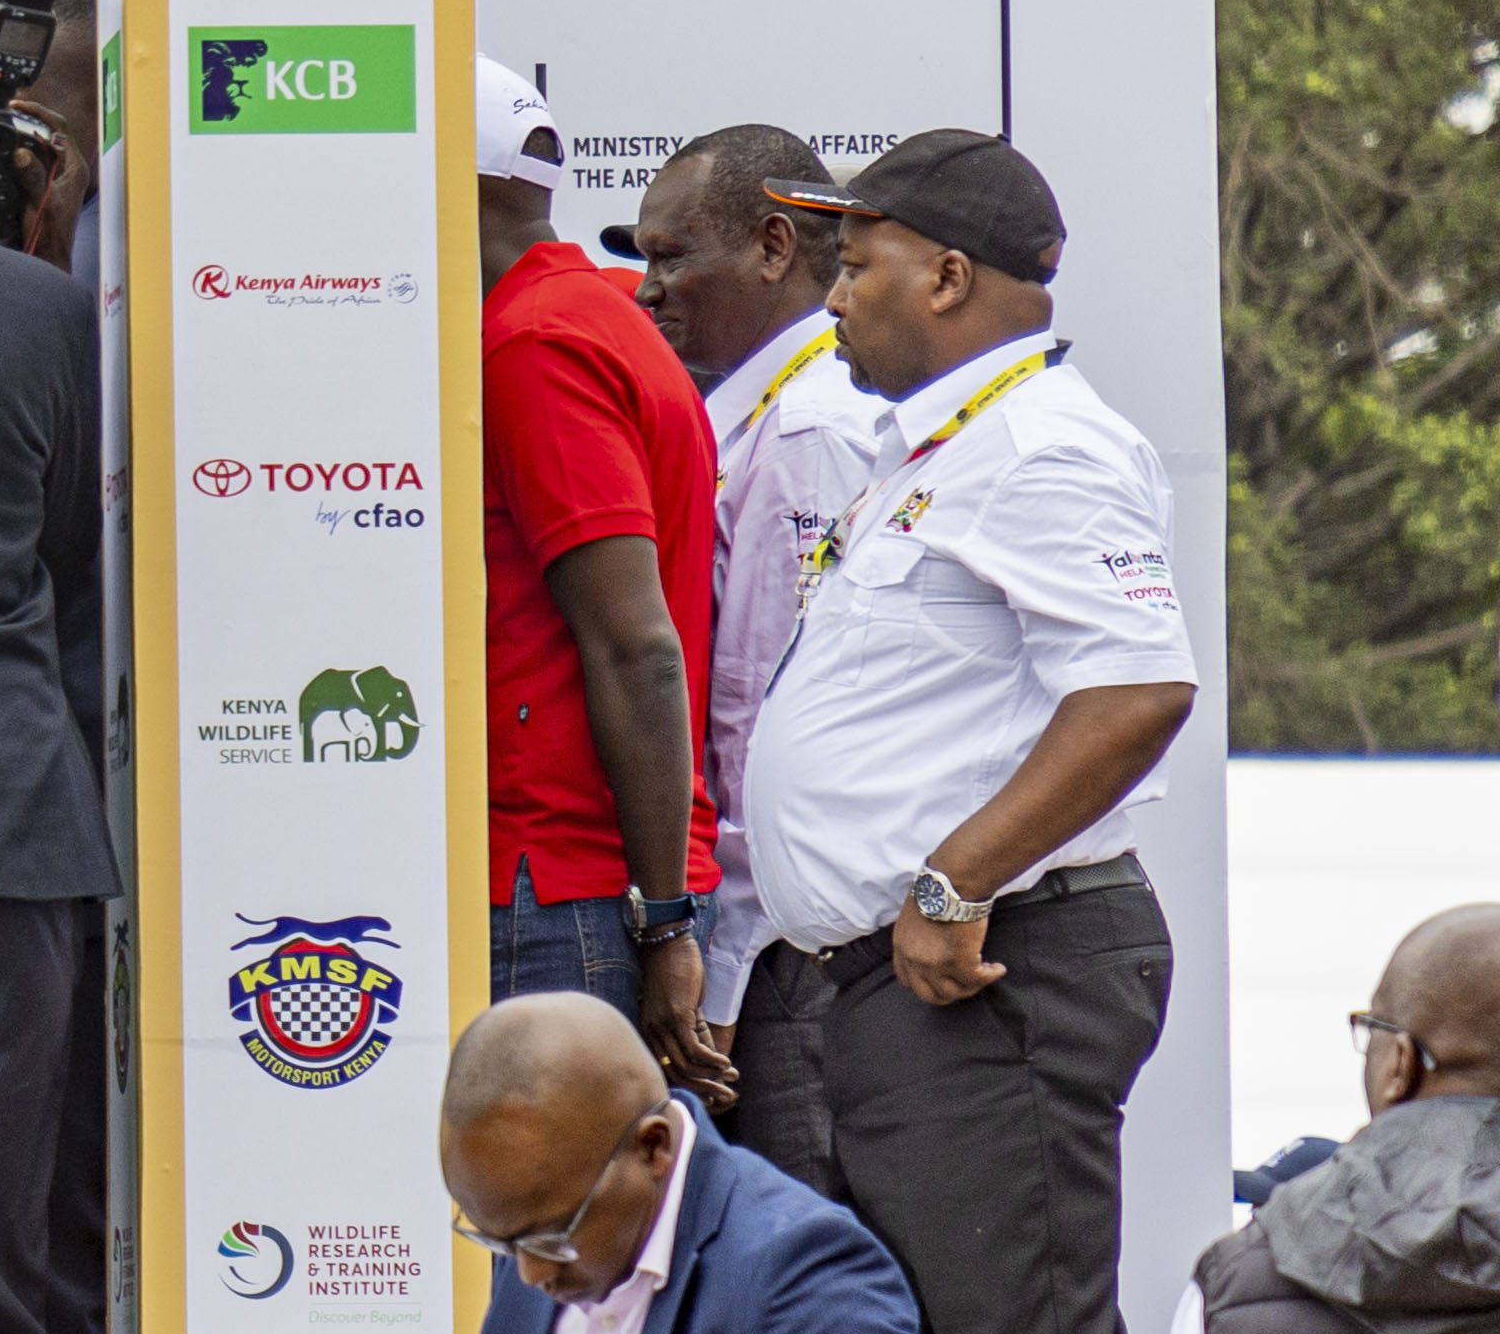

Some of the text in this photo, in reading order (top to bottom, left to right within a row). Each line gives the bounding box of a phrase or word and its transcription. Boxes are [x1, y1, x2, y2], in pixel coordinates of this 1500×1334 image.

[266, 59, 356, 100] KCB
[574, 137, 687, 161] MINISTRY
[573, 169, 614, 188] THE
[236, 275, 380, 293] Kenya Airways
[260, 463, 423, 492] TOYOTA
[316, 502, 424, 535] by cfao
[223, 700, 287, 714] KENYA
[198, 725, 291, 741] WILDLIFE
[220, 749, 292, 764] SERVICE
[238, 956, 393, 994] KMSF
[246, 1037, 385, 1087] MOTORSPORT KENYA
[308, 1226, 400, 1239] WILDLIFE
[309, 1244, 409, 1257] RESEARCH
[308, 1263, 420, 1276] & TRAINING
[310, 1281, 408, 1295] INSTITUTE
